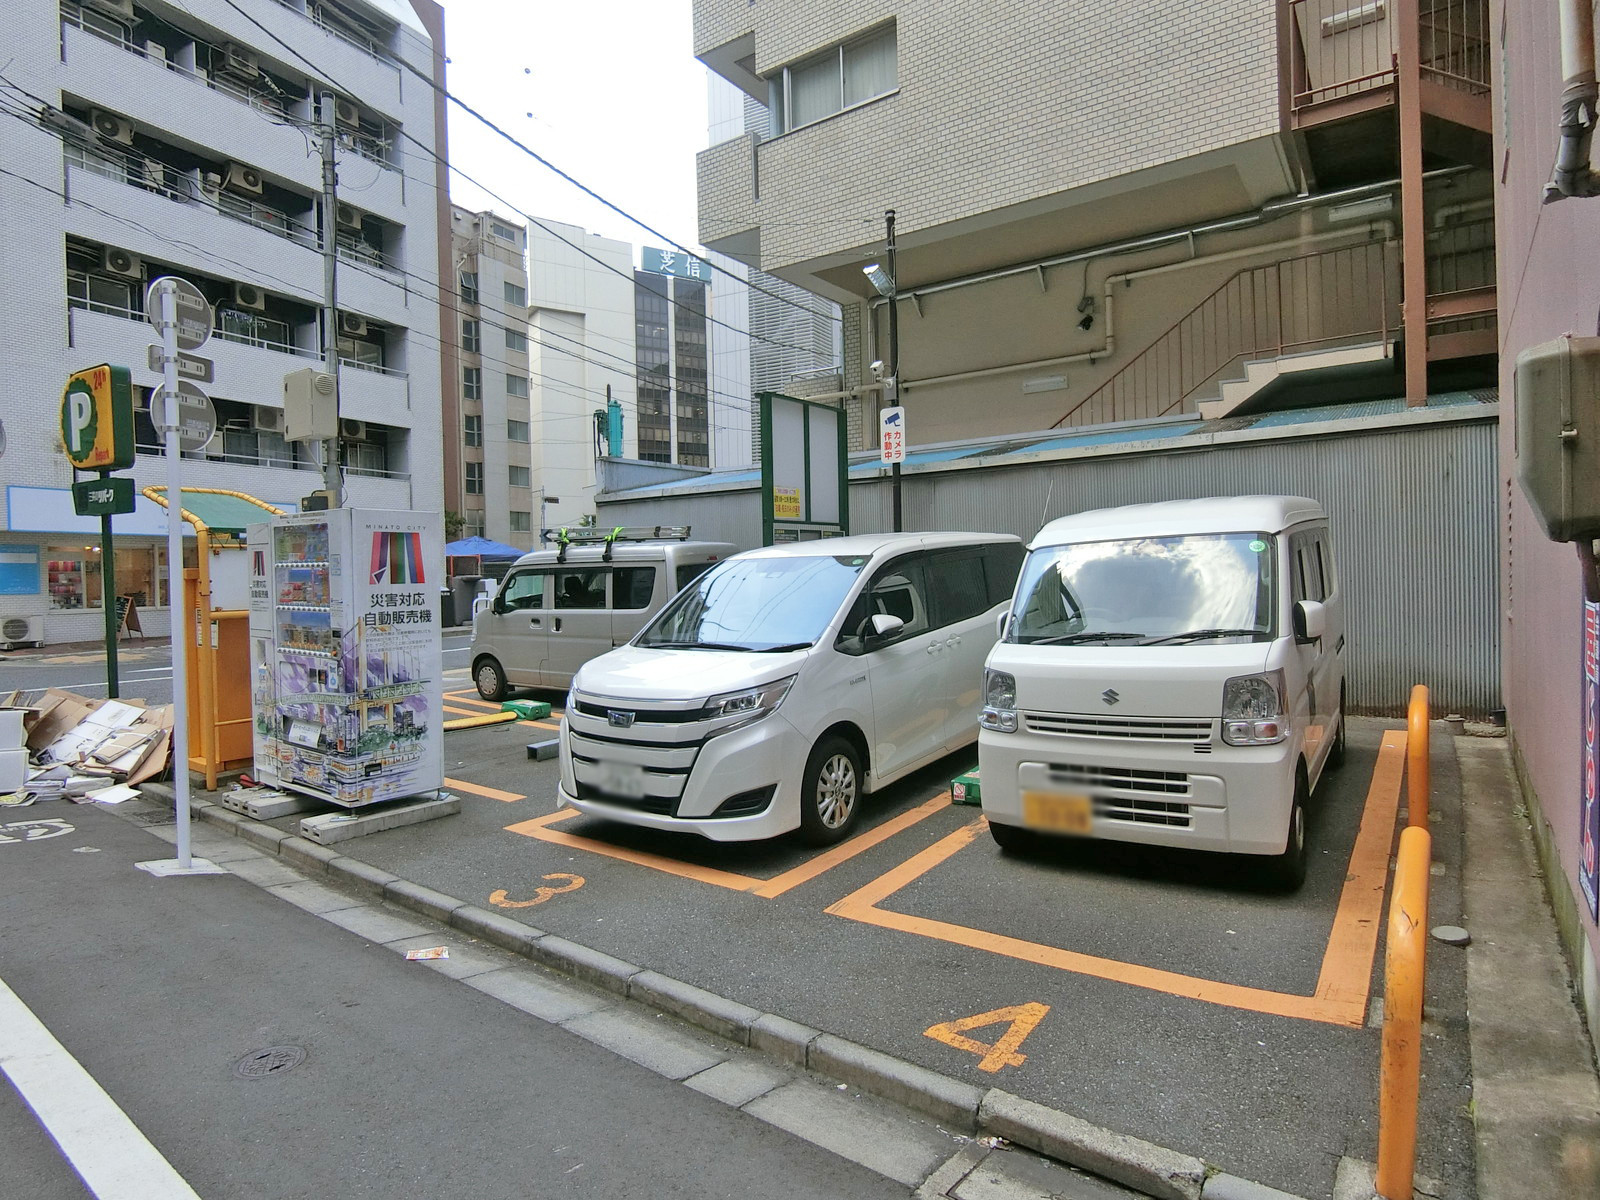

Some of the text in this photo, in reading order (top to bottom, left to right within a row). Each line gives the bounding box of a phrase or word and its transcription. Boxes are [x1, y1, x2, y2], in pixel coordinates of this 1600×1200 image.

[660, 250, 700, 278] 芝信
[93, 370, 107, 391] 24h
[71, 392, 92, 452] P
[884, 431, 893, 460] 作動中
[894, 431, 902, 459] カメラ
[370, 592, 426, 608] 災害対応
[364, 609, 432, 627] 自動販売機
[489, 872, 586, 909] 3
[923, 1001, 1051, 1074] 4
